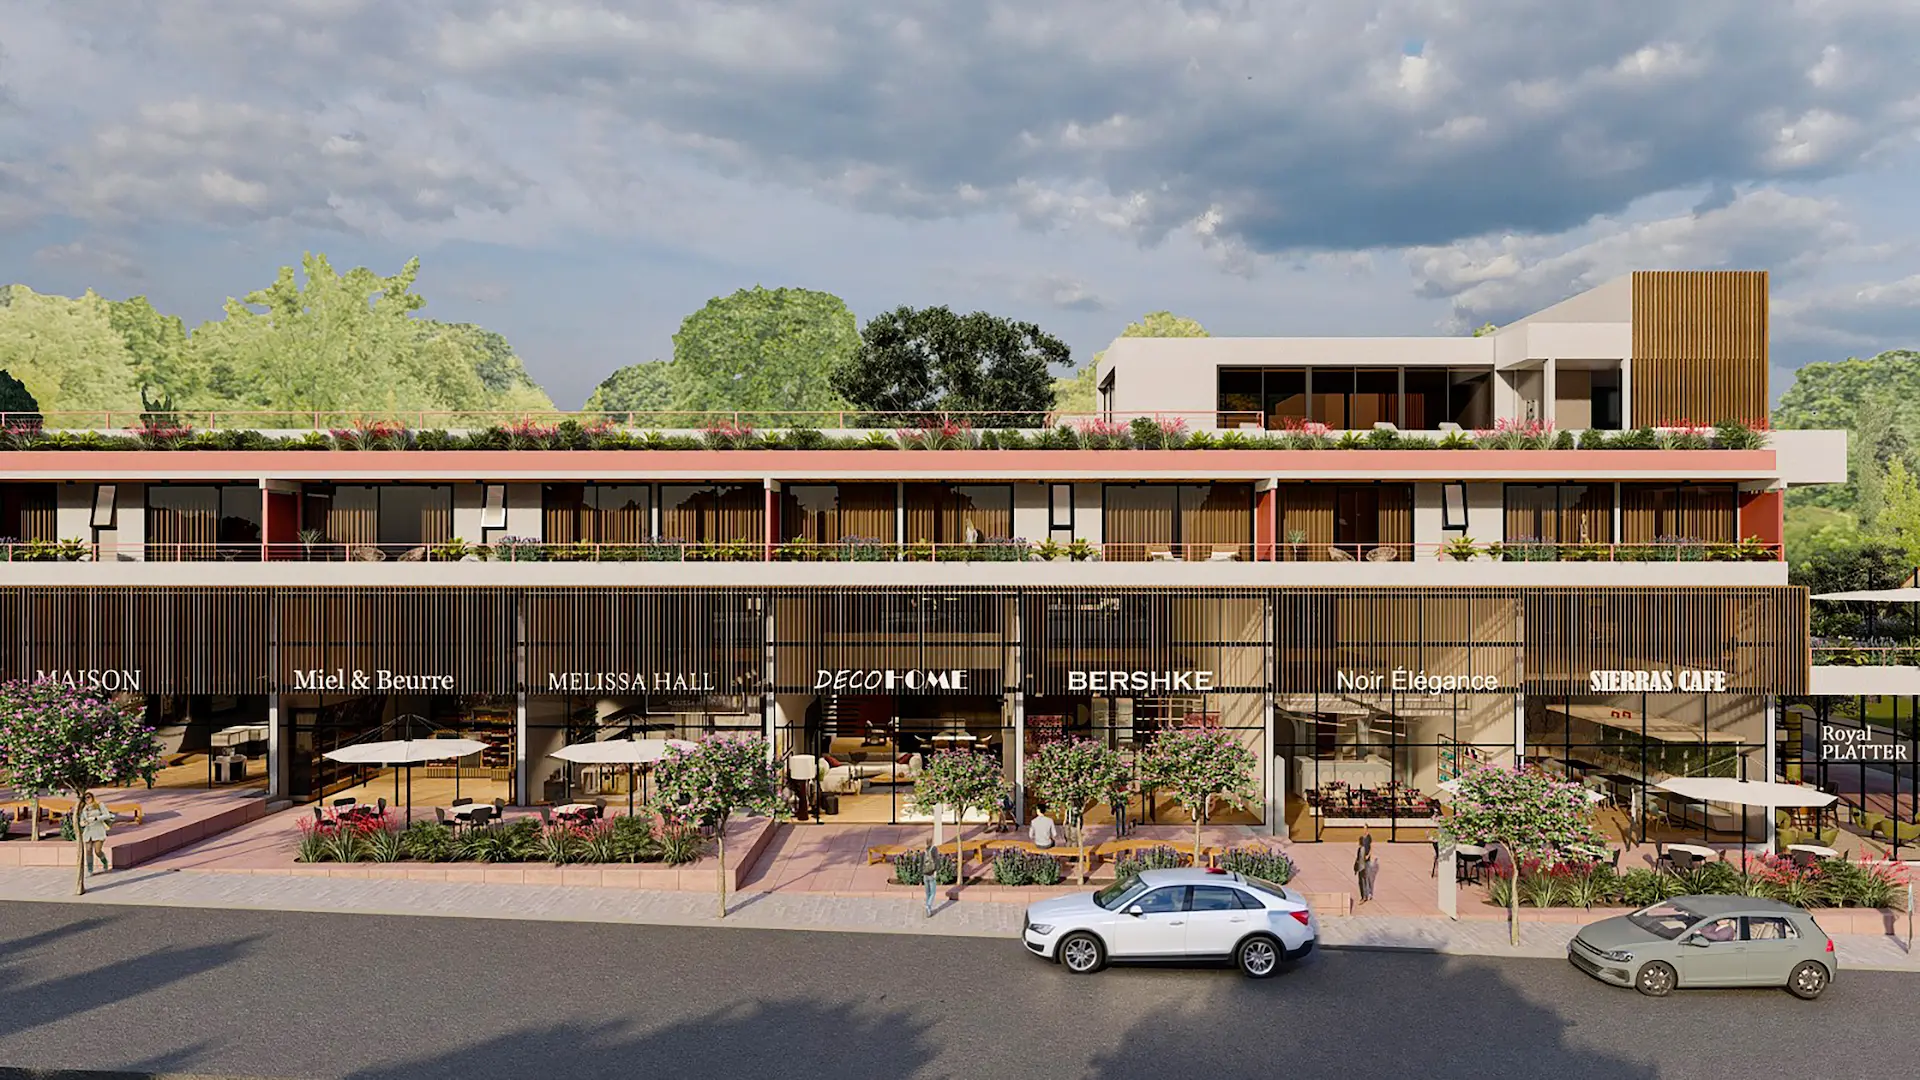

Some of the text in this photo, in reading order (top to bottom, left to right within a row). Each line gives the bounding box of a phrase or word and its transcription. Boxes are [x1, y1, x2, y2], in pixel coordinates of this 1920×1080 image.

[36, 669, 141, 691] MAISON
[293, 668, 454, 690] Miel & Beurre
[549, 672, 715, 691] MELISSA HALL
[1068, 670, 1213, 691] BERSHKE
[1337, 666, 1498, 694] Noir Élégance
[1590, 669, 1726, 692] SIERRAS CAFE
[1822, 725, 1872, 745] Royal
[1822, 744, 1908, 760] PLATTER
